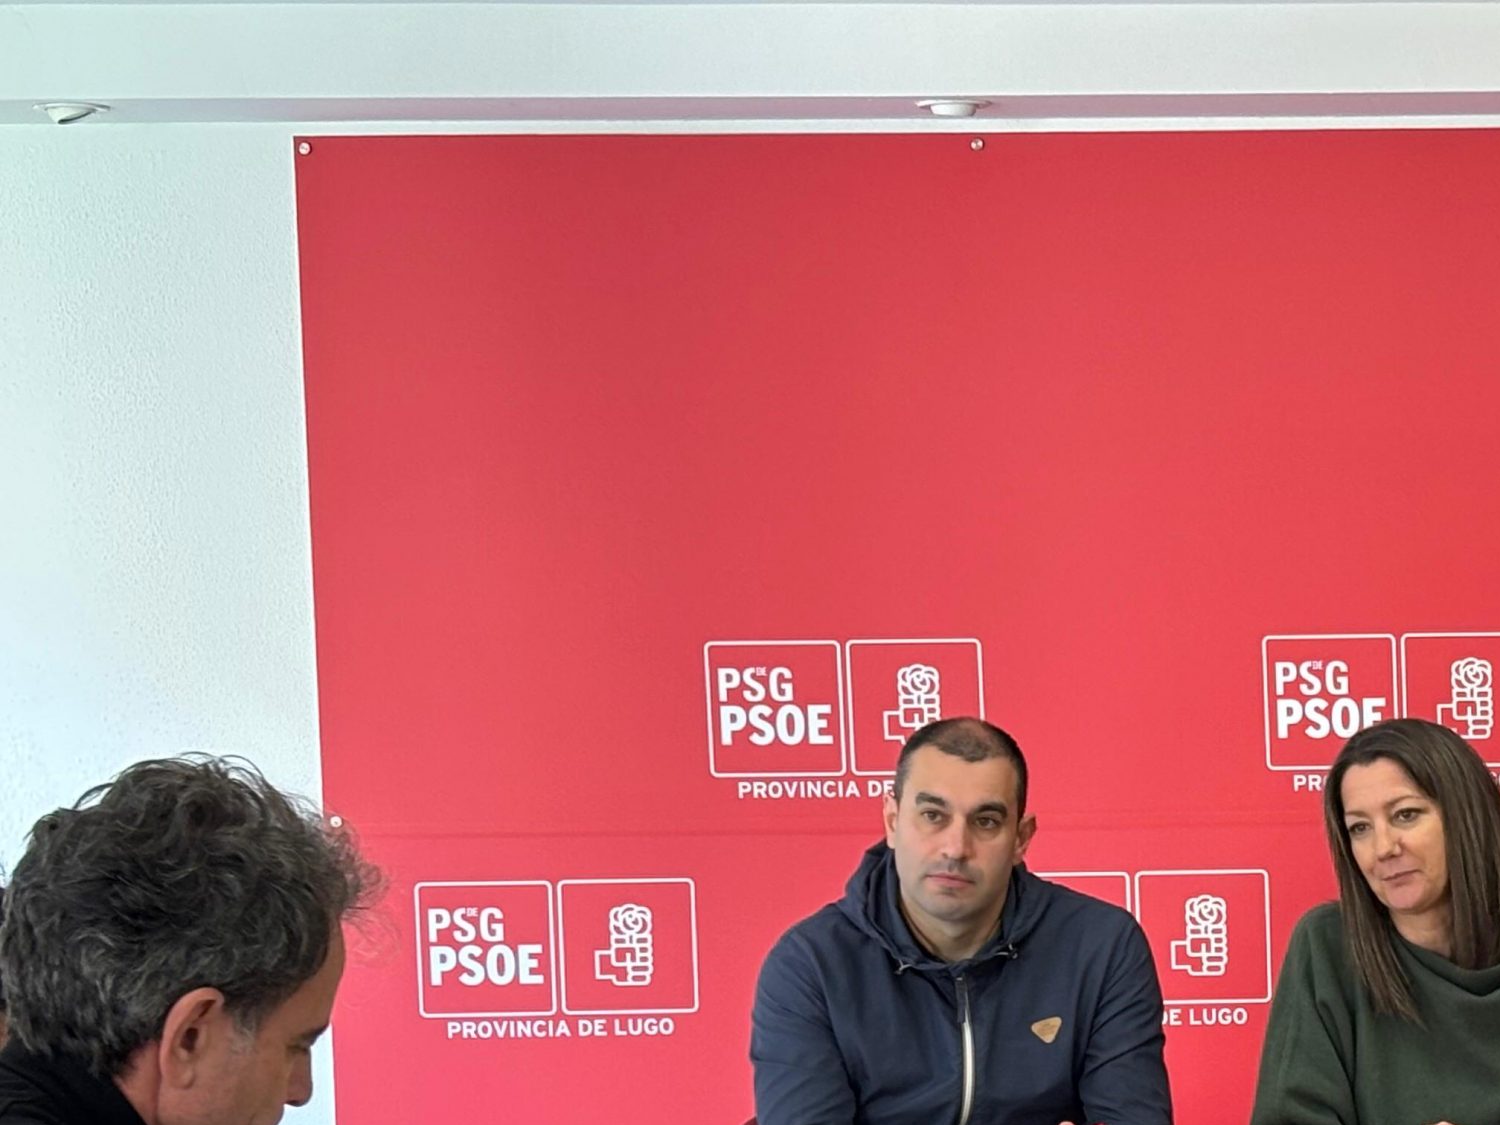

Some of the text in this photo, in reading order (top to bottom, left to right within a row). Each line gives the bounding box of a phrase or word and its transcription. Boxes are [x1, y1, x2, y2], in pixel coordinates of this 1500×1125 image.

[719, 704, 834, 746] PSOE
[737, 780, 861, 799] PROVINCIA
[429, 944, 545, 986] PSOE
[1188, 1007, 1248, 1025] LUGO
[447, 1017, 675, 1039] PROVINCIA DE LUGO
